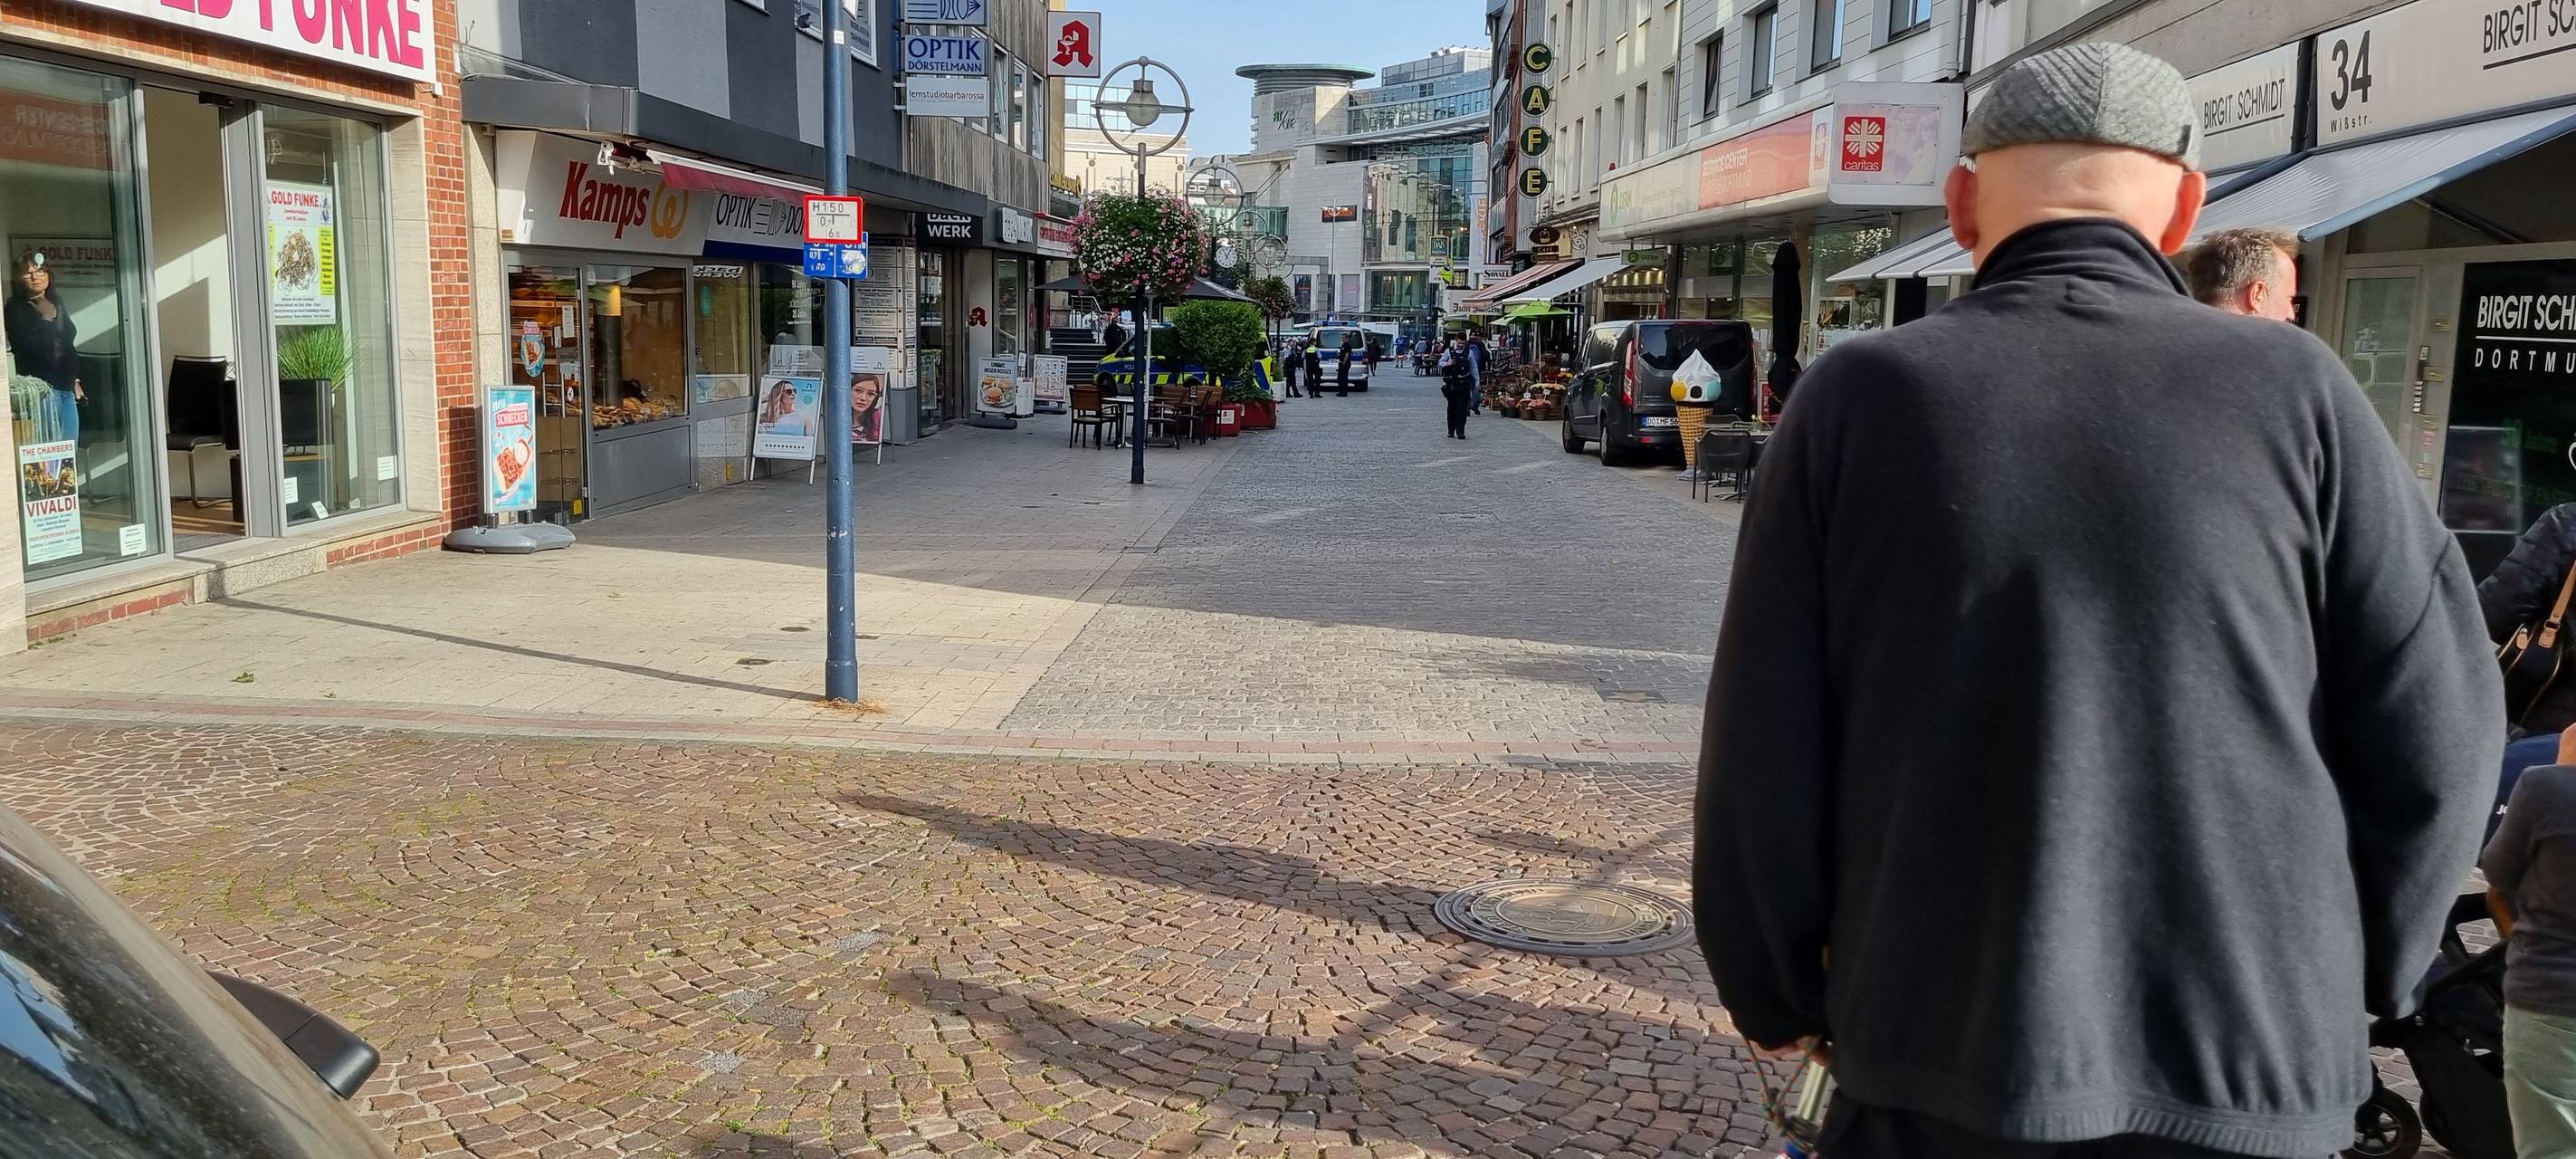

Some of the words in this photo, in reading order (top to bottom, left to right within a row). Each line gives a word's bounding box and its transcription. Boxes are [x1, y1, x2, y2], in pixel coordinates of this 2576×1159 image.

[2483, 0, 2542, 54] BIRGIT
[2547, 0, 2576, 37] SC
[908, 38, 981, 60] OPTIK
[908, 60, 982, 72] DÖRSTELMANN
[2330, 30, 2371, 110] 34
[909, 90, 985, 101] lernstudiobarbarossa
[2204, 94, 2233, 129] BIRGIT
[2237, 78, 2285, 120] SCHMIDT
[1526, 46, 1548, 194] CAFE
[2330, 114, 2372, 133] Wißstr.
[1724, 148, 1748, 170] CENTER
[1844, 161, 1879, 171] caritas
[272, 190, 292, 206] GOLD
[294, 193, 320, 208] FUNKE
[558, 160, 651, 240] Kamps
[716, 193, 757, 229] OPTIK
[927, 225, 972, 238] WERK
[2476, 295, 2533, 330] BIRGIT
[2533, 294, 2576, 330] SCH
[22, 448, 36, 457] THE
[37, 444, 73, 455] CHAMBERS
[25, 495, 77, 518] VIVALDI
